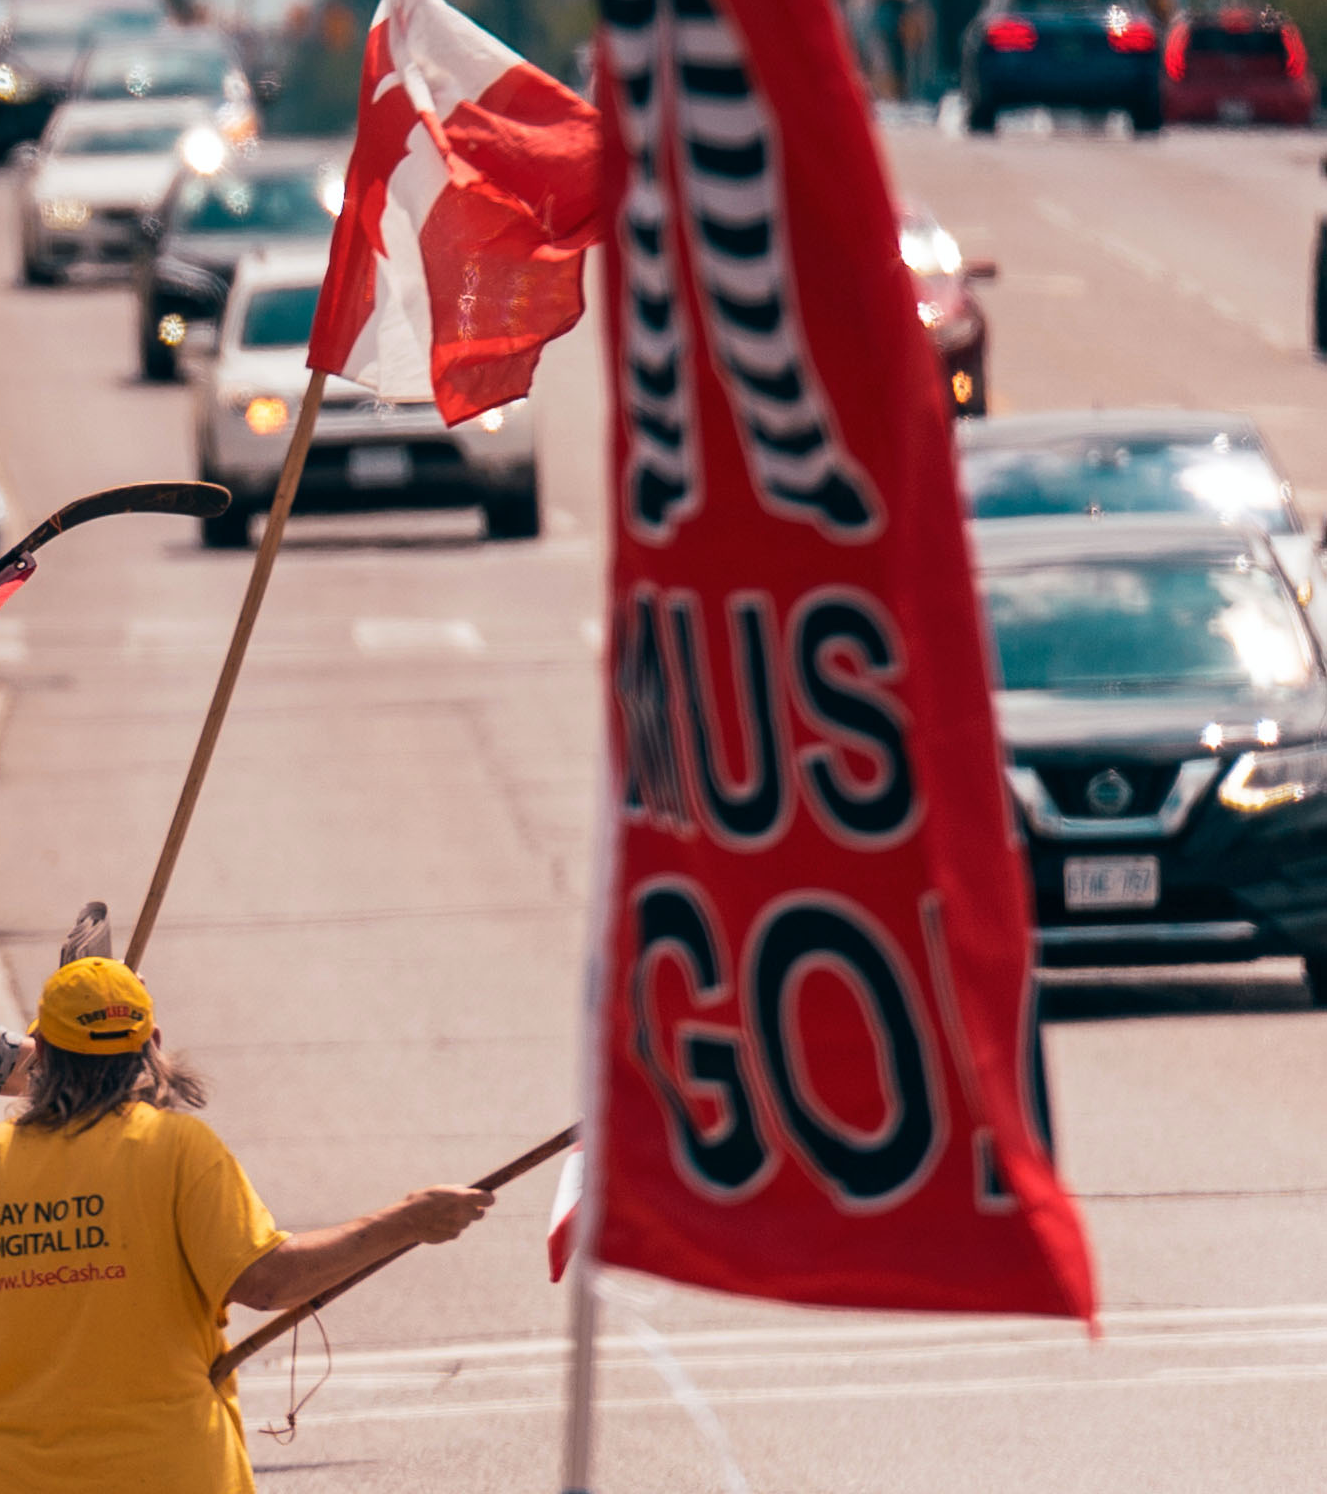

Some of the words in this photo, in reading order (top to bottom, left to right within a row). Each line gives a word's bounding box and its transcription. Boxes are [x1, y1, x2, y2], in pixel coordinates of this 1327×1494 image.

[34, 1200, 69, 1224] NO
[71, 1194, 104, 1218] TO
[75, 1226, 109, 1250] I.D.
